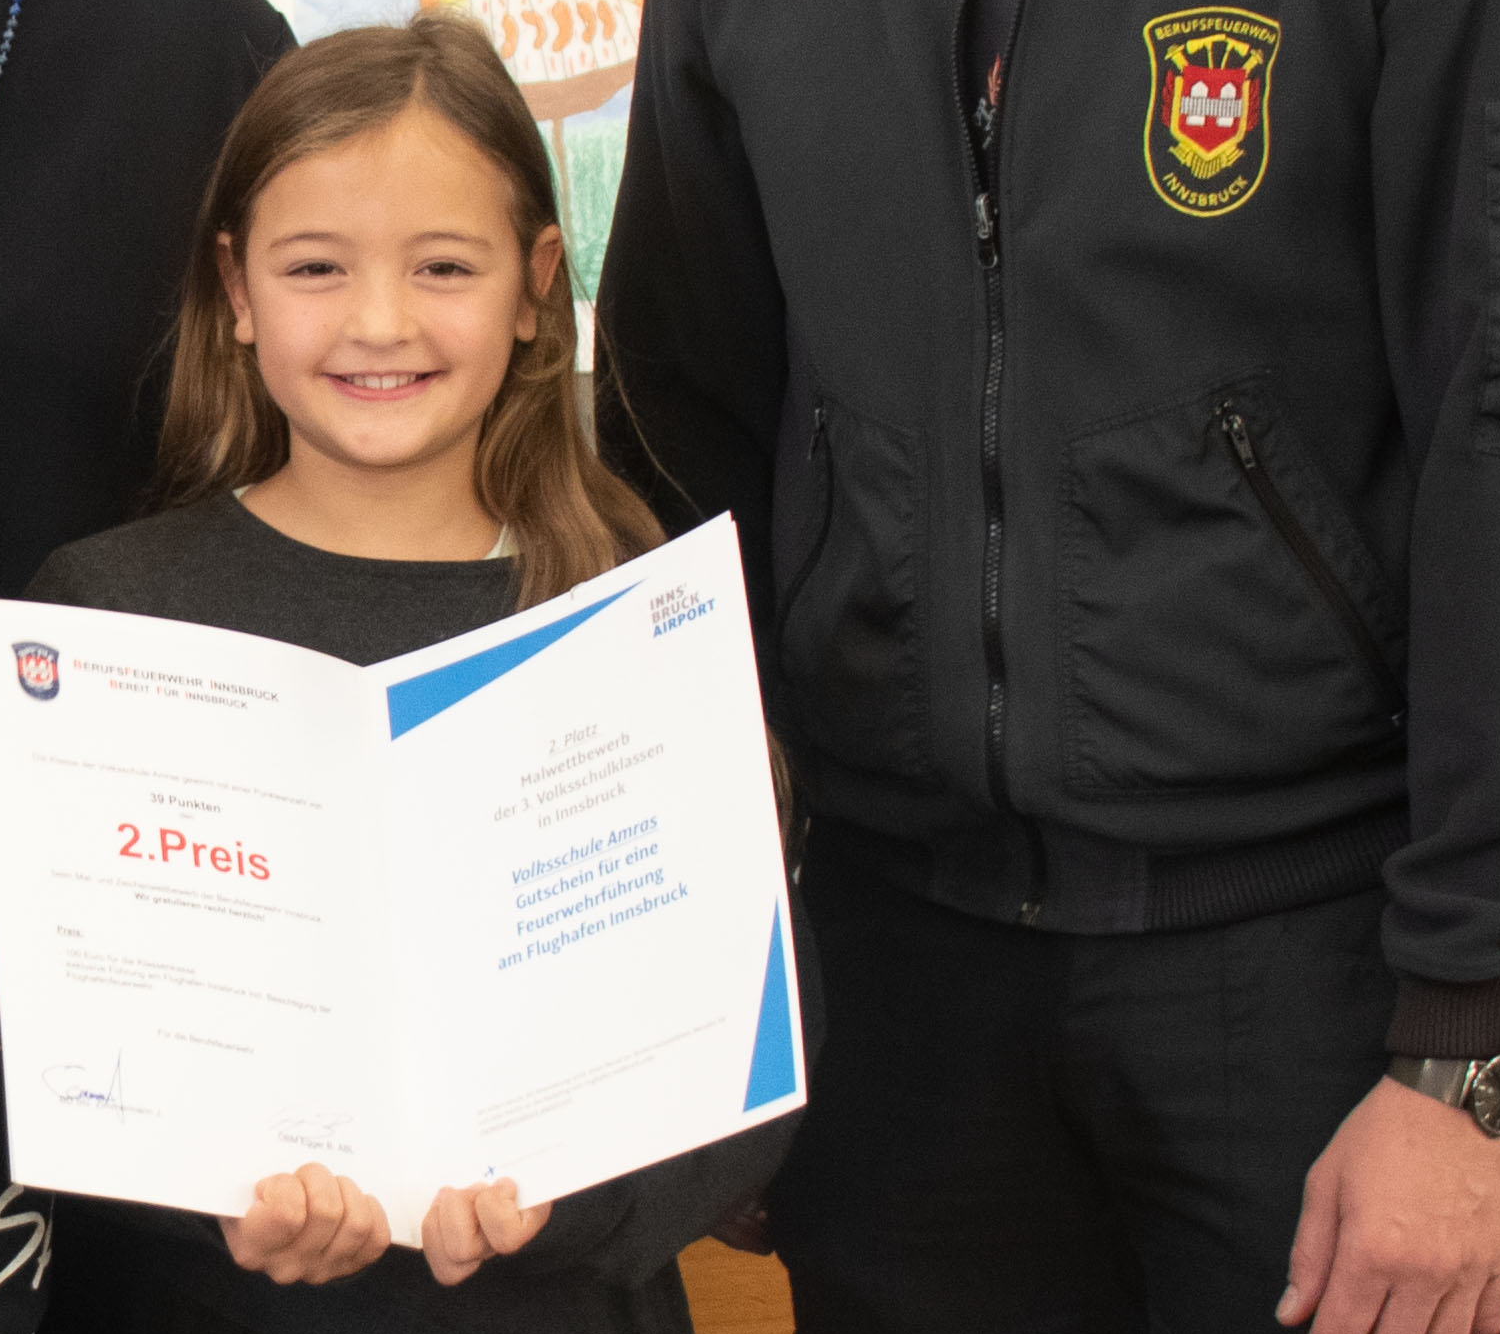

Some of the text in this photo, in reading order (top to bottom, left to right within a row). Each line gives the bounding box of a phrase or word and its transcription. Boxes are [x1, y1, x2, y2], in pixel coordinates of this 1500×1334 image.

[1154, 17, 1276, 44] BERUFSFEUERWEHR
[1162, 172, 1249, 207] INNSBRUCK
[652, 591, 700, 624] BRUCK
[653, 598, 715, 638] AIRPORT
[73, 658, 280, 703] BERUFSFEUERWEHR INNSBRUCK
[184, 690, 249, 710] INNSBRUCK
[563, 722, 599, 748] Platz
[493, 803, 517, 822] der
[536, 741, 665, 805] Volksschulklassen
[520, 731, 631, 789] Malwettbewerb
[149, 791, 165, 806] 39
[168, 793, 222, 814] Punkten
[537, 780, 627, 829] in Innsbruck
[512, 814, 659, 886] Volksschule Amras
[515, 841, 660, 910] Gutschein für eine
[516, 866, 665, 937] Feuerwehrführung
[497, 881, 689, 971] am Flughafen Innsbruck
